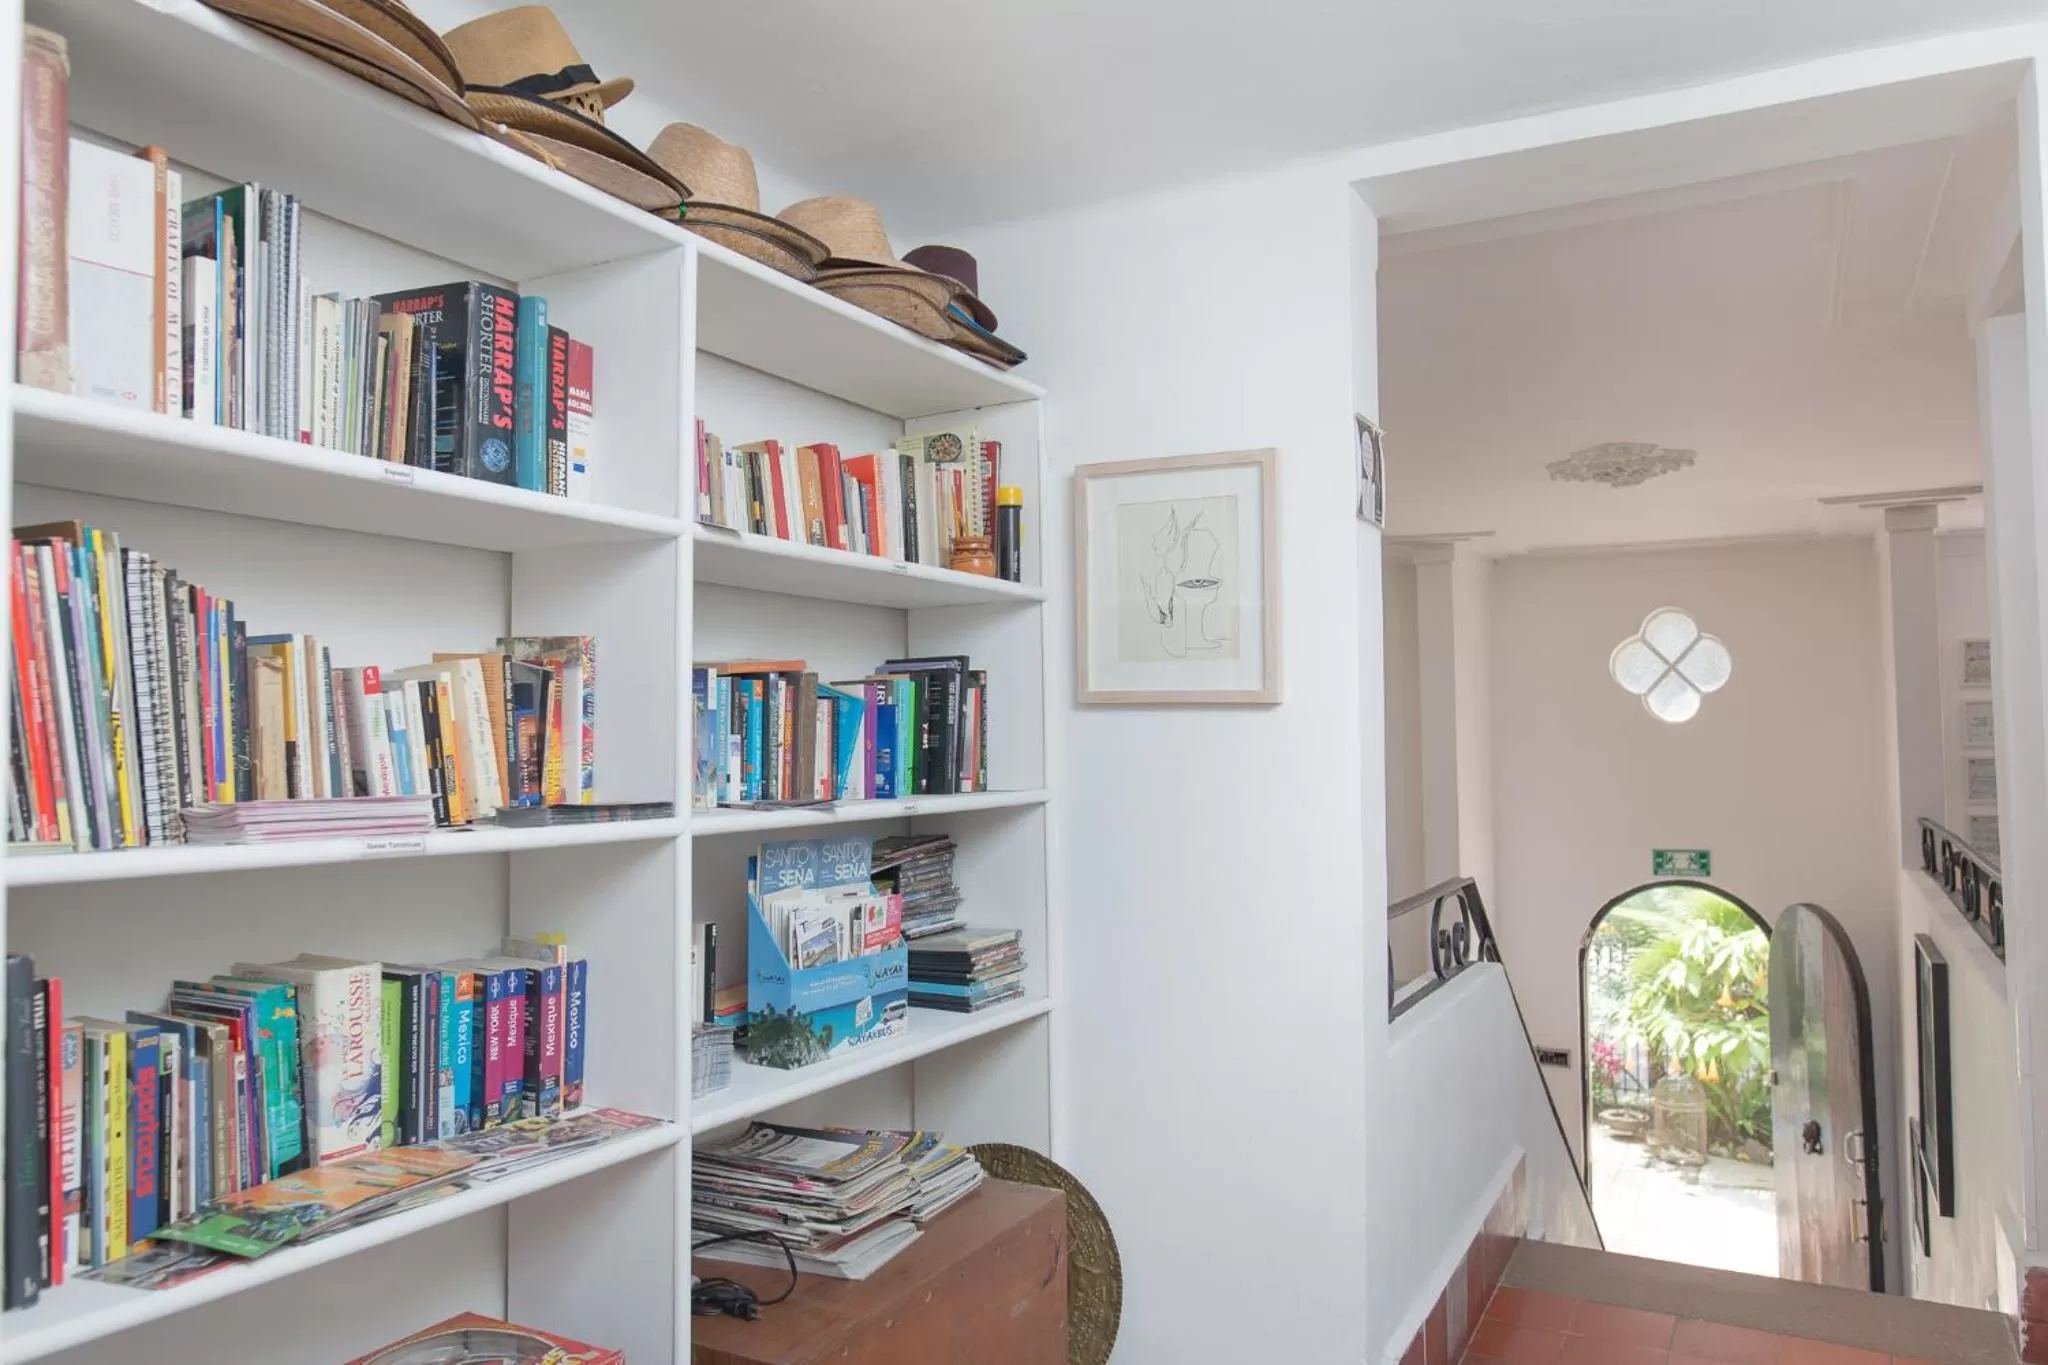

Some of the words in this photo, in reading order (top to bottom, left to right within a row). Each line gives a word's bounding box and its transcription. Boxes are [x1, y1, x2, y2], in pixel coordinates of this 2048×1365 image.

[167, 207, 182, 274] CRAFTS
[479, 292, 495, 376] SHORTER
[493, 295, 516, 431] HARRAP'S
[552, 335, 567, 431] HARRAP'S
[764, 845, 810, 869] SANTO
[822, 842, 864, 863] SANTO
[348, 973, 364, 1078] LAROUSSE
[457, 1009, 470, 1065] Mexico
[489, 1005, 500, 1035] YORK
[489, 1036, 500, 1061] NEW
[507, 999, 519, 1047] Mexique
[546, 996, 558, 1056] Mexique
[569, 991, 581, 1049] Mexico
[136, 1066, 160, 1198] spartacus
